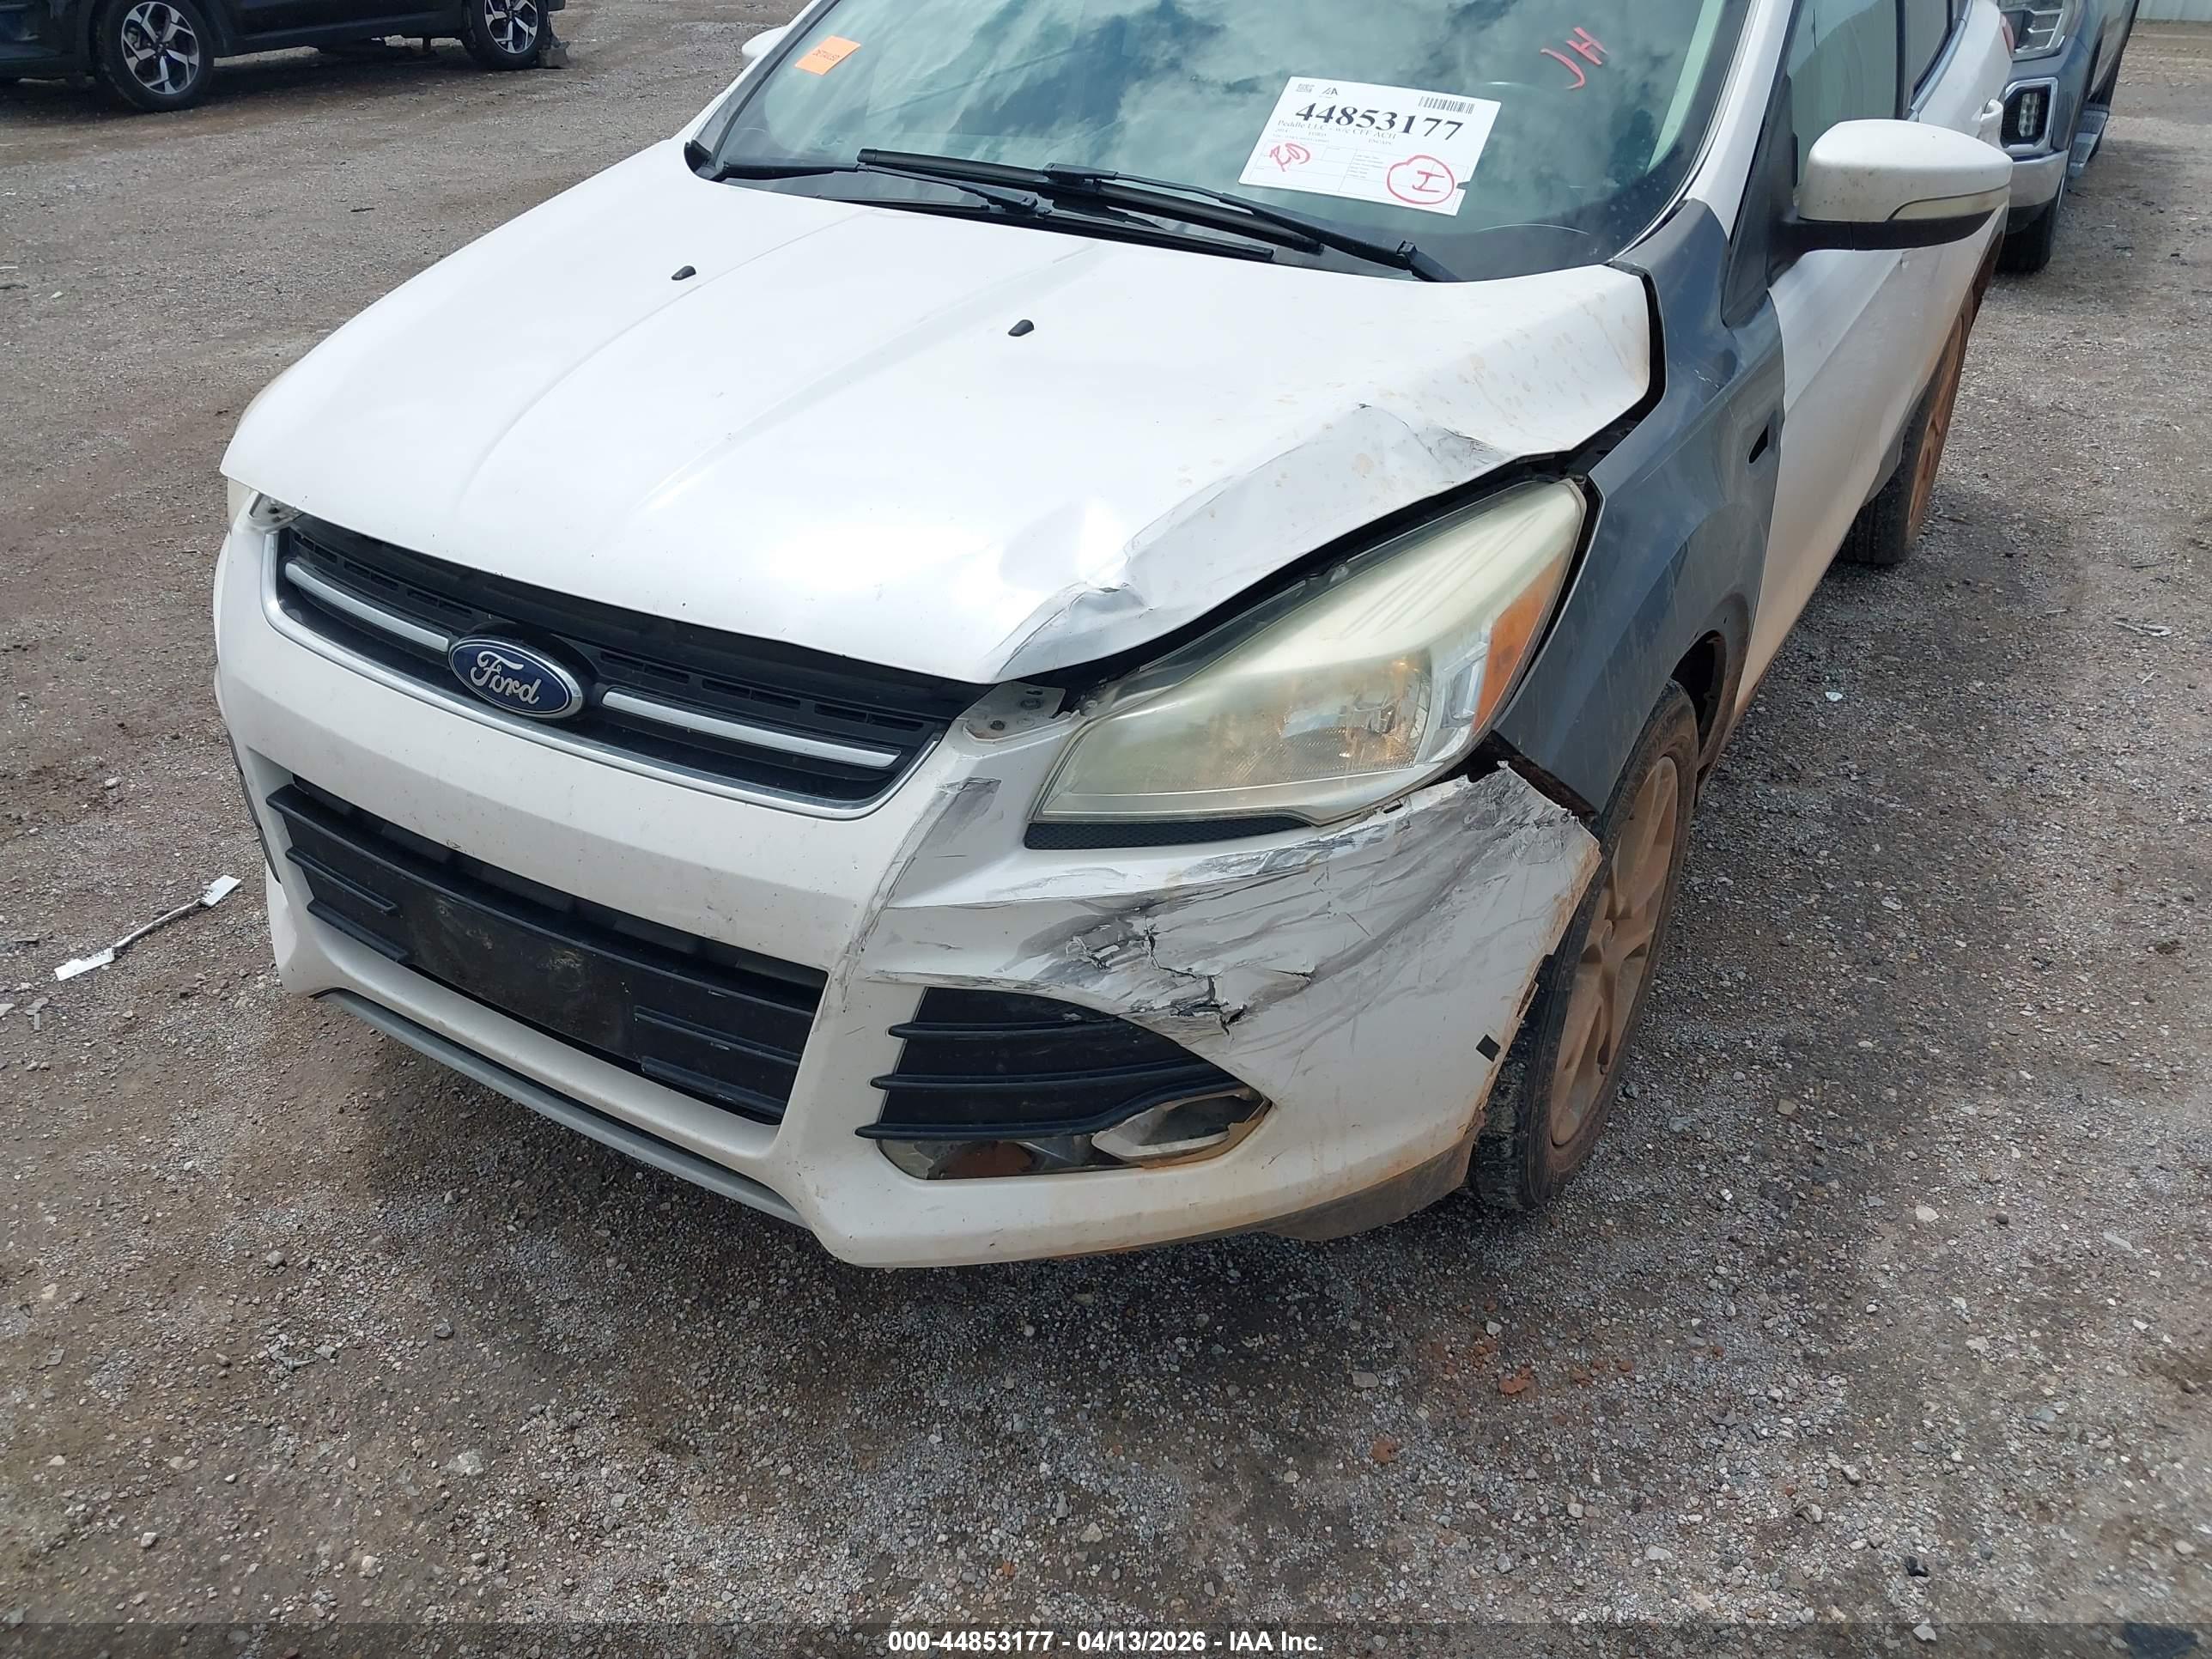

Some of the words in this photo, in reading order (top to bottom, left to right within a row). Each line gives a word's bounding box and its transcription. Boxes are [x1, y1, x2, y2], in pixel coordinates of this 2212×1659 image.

[1277, 119, 1306, 129] Peddle
[1295, 102, 1464, 141] 44853177
[470, 650, 542, 705] Ford
